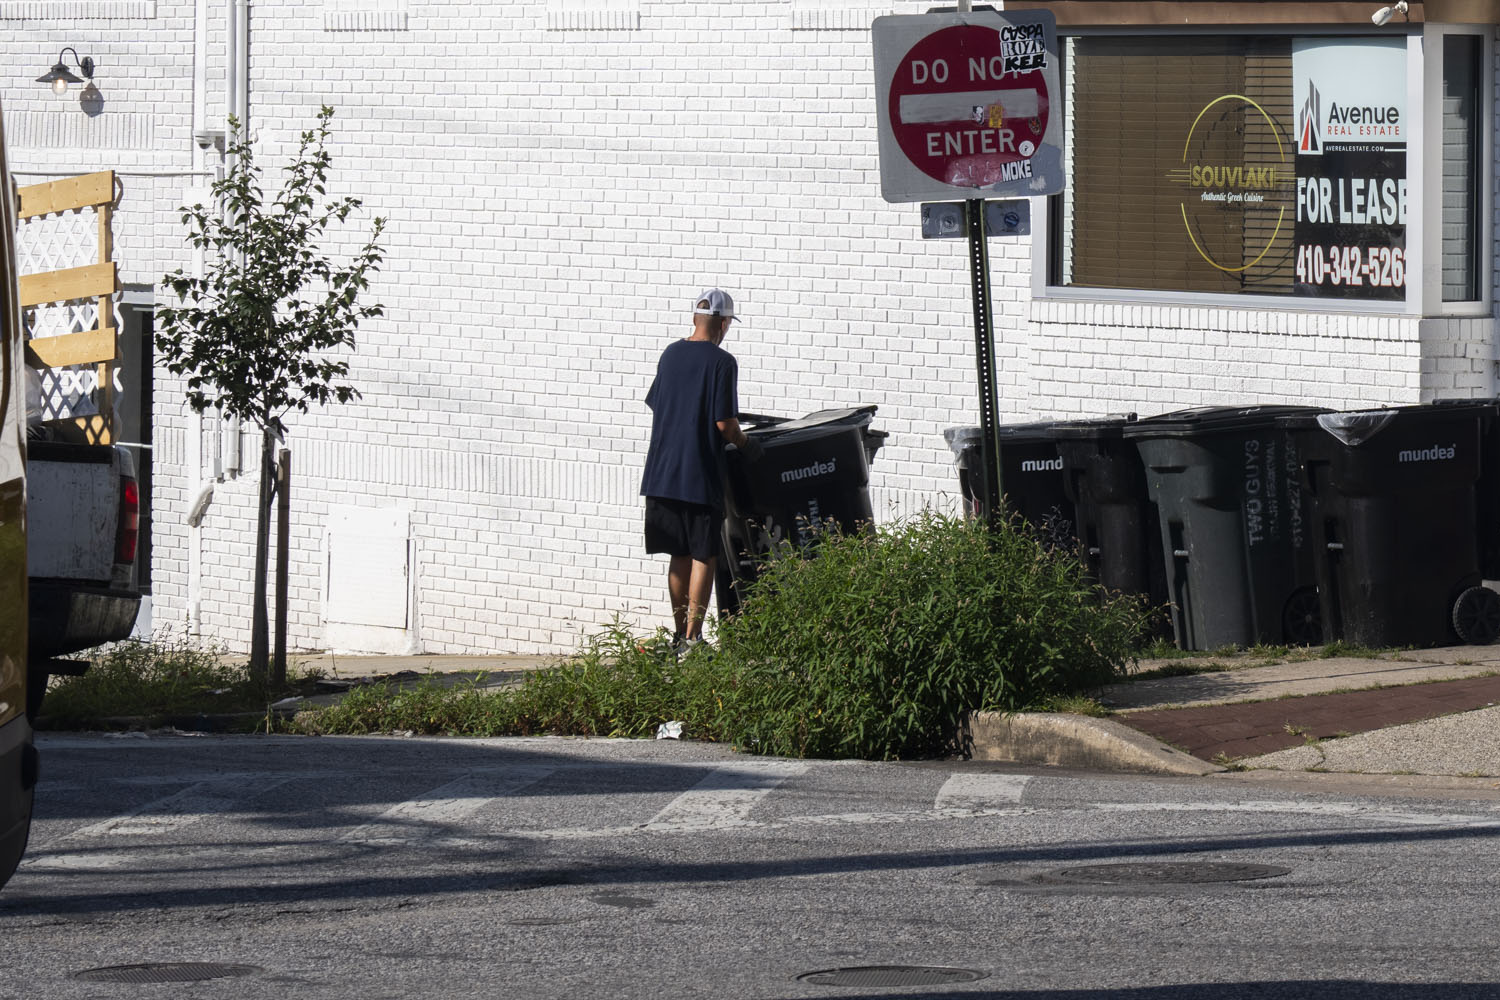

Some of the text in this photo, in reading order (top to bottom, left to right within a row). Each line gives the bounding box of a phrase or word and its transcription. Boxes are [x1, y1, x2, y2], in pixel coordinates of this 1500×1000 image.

[912, 56, 1018, 85] DO NO
[1328, 102, 1400, 125] Avenue
[1327, 125, 1400, 136] REAL ESTATE
[926, 129, 1016, 157] ENTER
[1001, 160, 1032, 182] MOKE
[1191, 165, 1274, 188] SOUVLAKI
[1297, 177, 1334, 224] FOR
[1399, 443, 1456, 463] mundea
[781, 457, 836, 483] mundea
[1245, 440, 1263, 546] TWO GUYS
